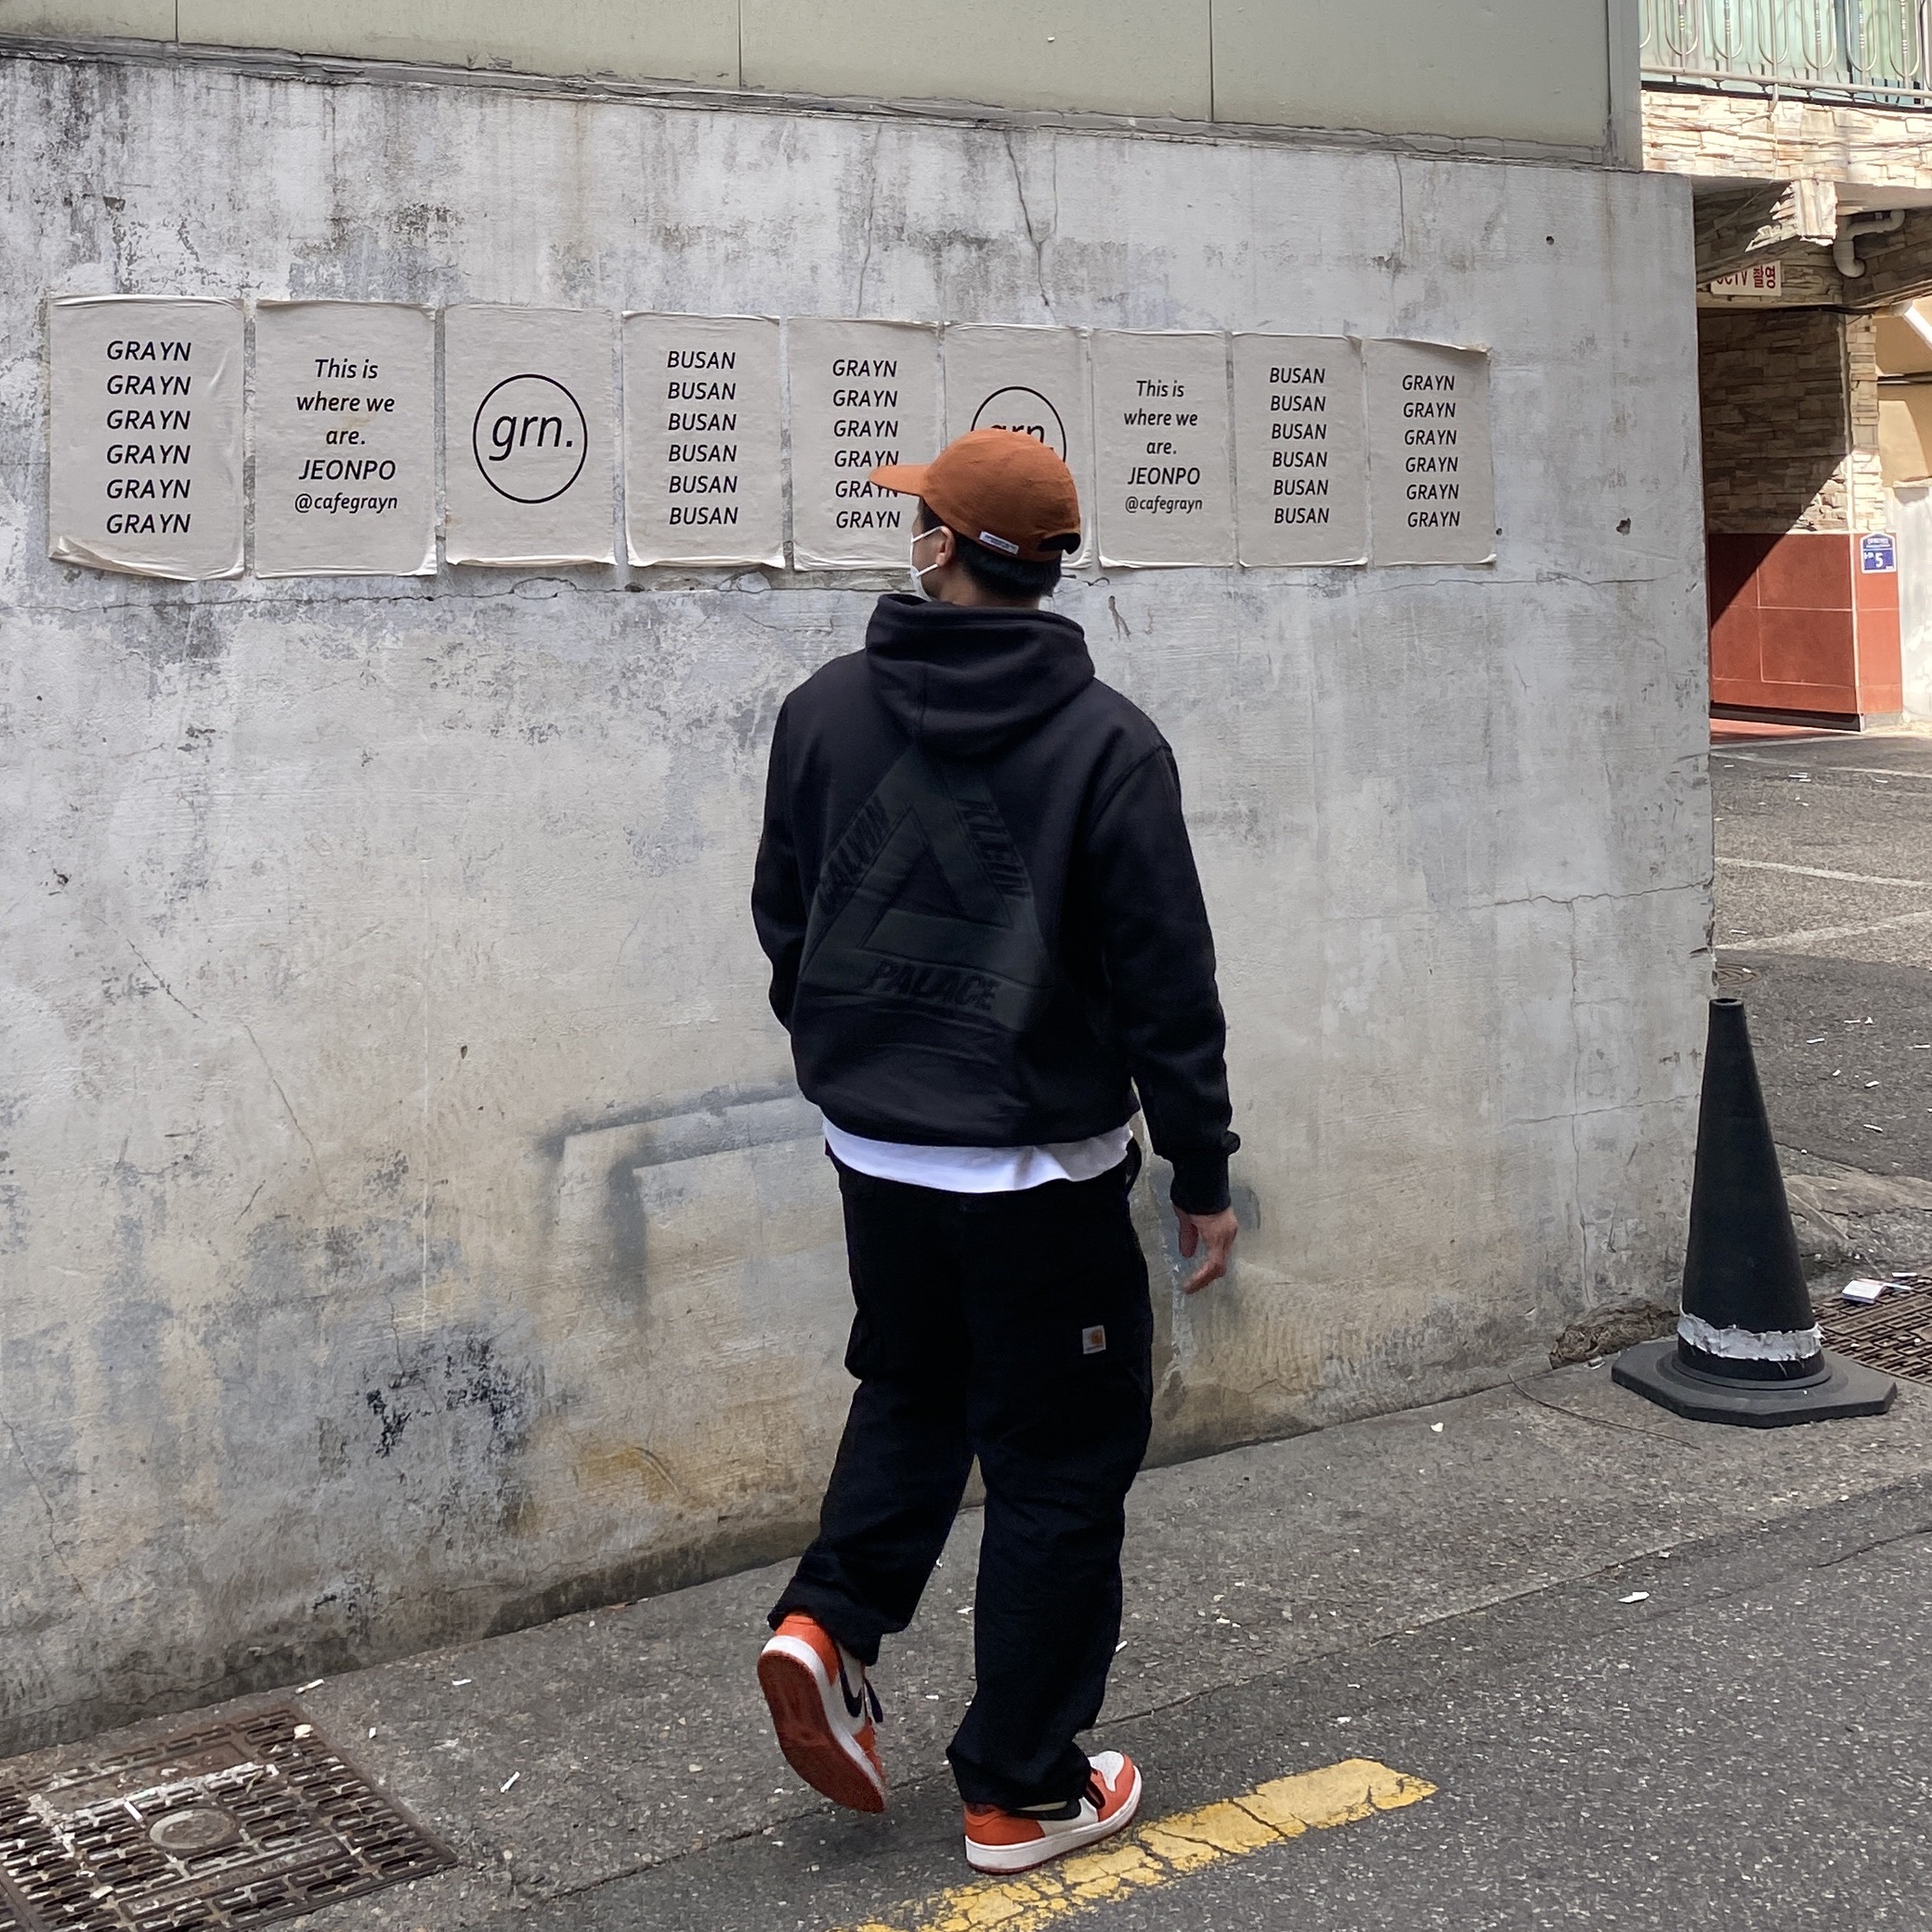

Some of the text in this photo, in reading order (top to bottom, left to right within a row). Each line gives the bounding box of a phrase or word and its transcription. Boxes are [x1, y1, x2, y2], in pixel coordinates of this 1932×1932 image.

[107, 340, 191, 361] GRAYN
[667, 350, 738, 370] BUSAN
[314, 358, 379, 379] This is
[832, 359, 897, 378] GRAYN
[1269, 367, 1326, 385] BUSAN
[107, 374, 191, 396] GRAYN
[667, 382, 738, 400] BUSAN
[1136, 379, 1185, 398] This is
[1402, 374, 1456, 391] GRAYN
[296, 390, 396, 412] where we
[832, 389, 898, 408] GRAYN
[1270, 395, 1326, 412] BUSAN
[1123, 407, 1198, 426] where we
[1403, 401, 1456, 418] GRAYN
[106, 409, 191, 430] GRAYN
[667, 412, 738, 432] BUSAN
[833, 419, 899, 437] GRAYN
[325, 430, 366, 445] are.
[489, 415, 574, 462] grn.
[1271, 423, 1327, 440] BUSAN
[1403, 429, 1457, 446] GRAYN
[106, 444, 191, 464] GRAYN
[667, 444, 738, 463] BUSAN
[1146, 441, 1177, 455] are.
[834, 450, 899, 468] GRAYN
[1272, 450, 1328, 468] BUSAN
[1405, 456, 1458, 473] GRAYN
[298, 459, 397, 481] JEONPO
[1127, 466, 1201, 486] JEONPO
[106, 478, 191, 500] GRAYN
[667, 475, 738, 494] BUSAN
[1273, 478, 1329, 496] BUSAN
[1406, 483, 1460, 501] GRAYN
[294, 491, 398, 514] @cafegrayn
[1125, 494, 1203, 515] @cafegrayn
[106, 513, 191, 534] GRAYN
[667, 506, 738, 526] BUSAN
[836, 510, 900, 529] GRAYN
[1273, 507, 1330, 524] BUSAN
[1407, 510, 1461, 529] GRAYN
[1874, 552, 1884, 568] 5
[868, 961, 998, 1012] PALACE
